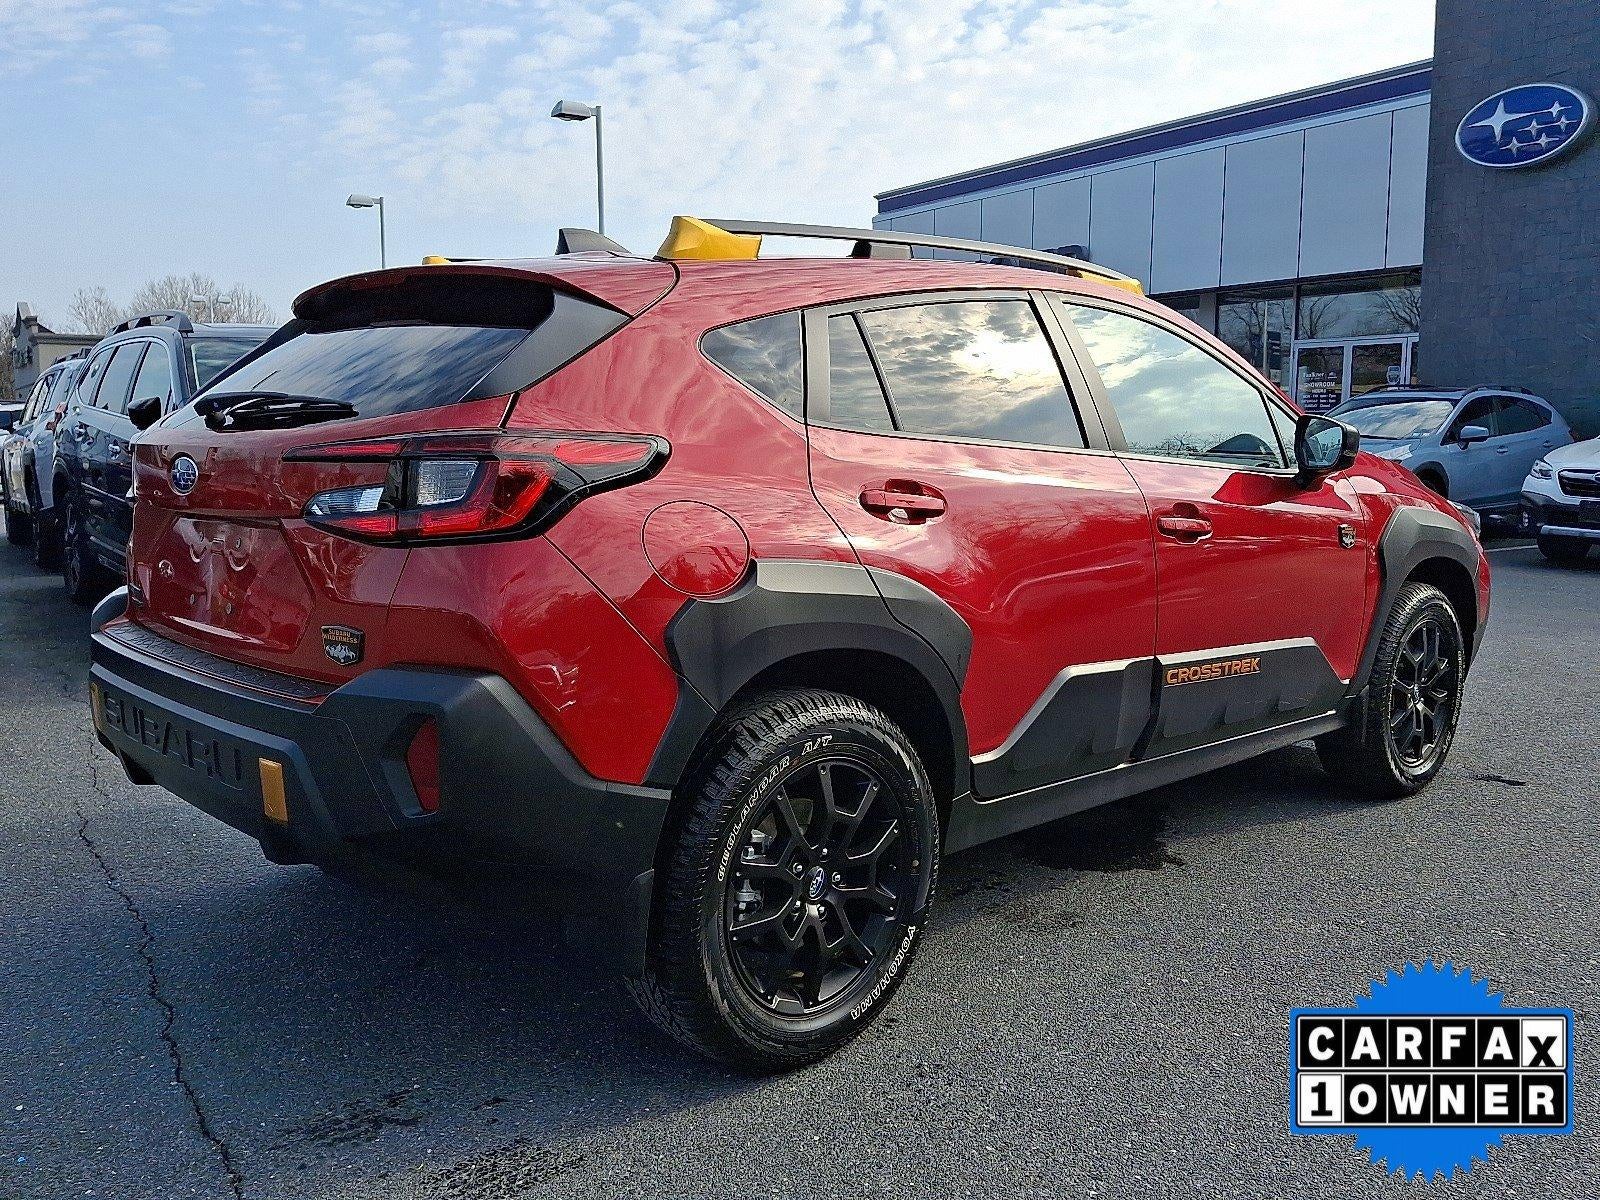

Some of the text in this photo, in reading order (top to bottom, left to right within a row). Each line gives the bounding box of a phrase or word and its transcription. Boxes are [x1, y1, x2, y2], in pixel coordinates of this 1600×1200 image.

[328, 628, 351, 638] SUBARU
[1166, 658, 1260, 684] CROSSTREK
[103, 690, 244, 791] SUBARU
[717, 735, 833, 881] GEOLANDAR A/T
[850, 925, 916, 1020] YOKOHAMA
